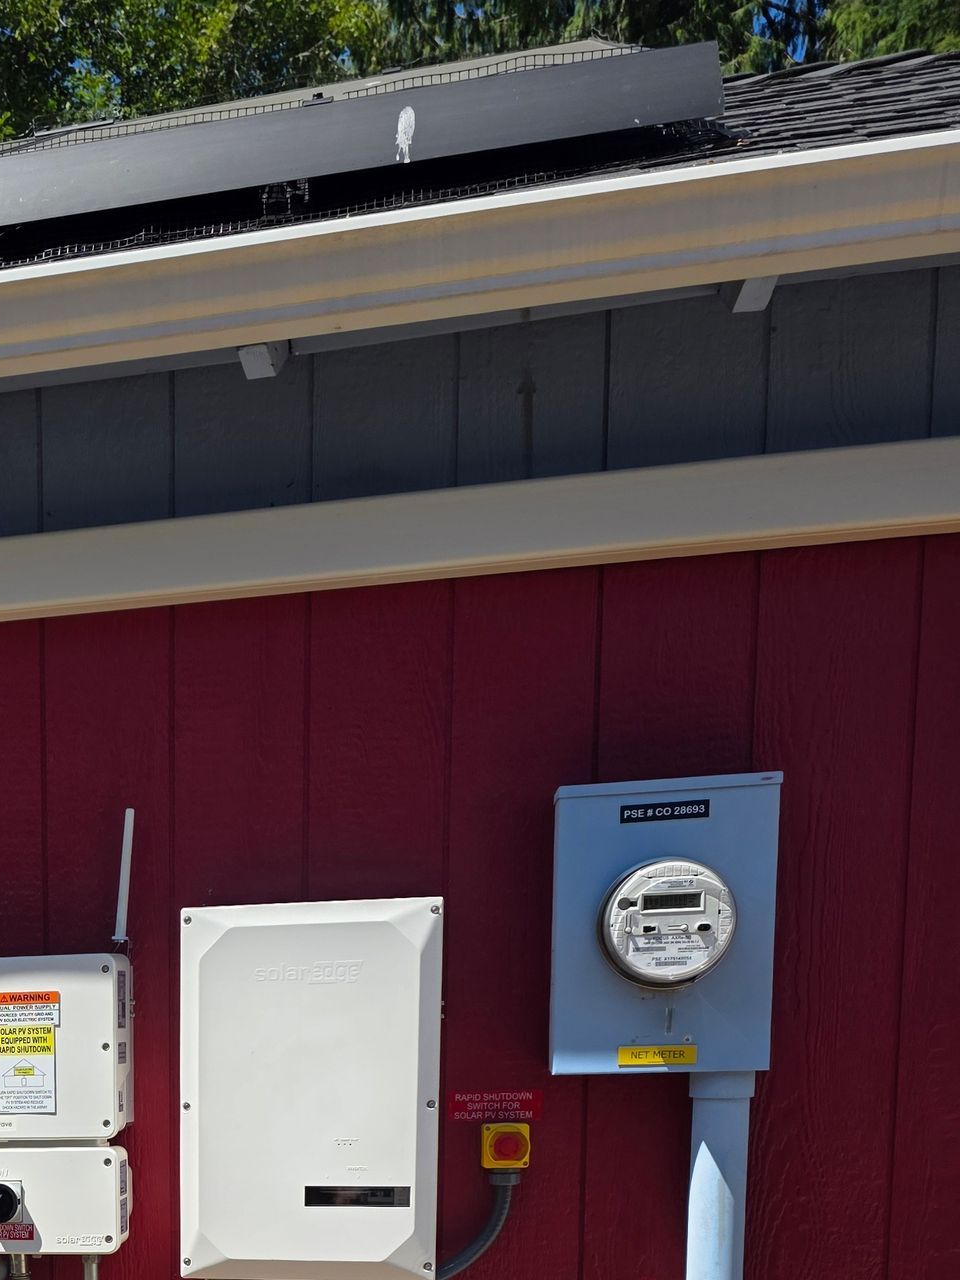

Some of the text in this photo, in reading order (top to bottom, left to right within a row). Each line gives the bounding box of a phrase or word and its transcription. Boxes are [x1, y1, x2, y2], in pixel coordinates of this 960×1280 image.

[624, 804, 706, 818] PSE # CO 28693
[255, 962, 360, 983] solaredge
[9, 994, 50, 1002] WARNING
[653, 1050, 685, 1059] METER
[483, 1092, 533, 1100] SHUTDOWN
[56, 1235, 104, 1246] solaredge
